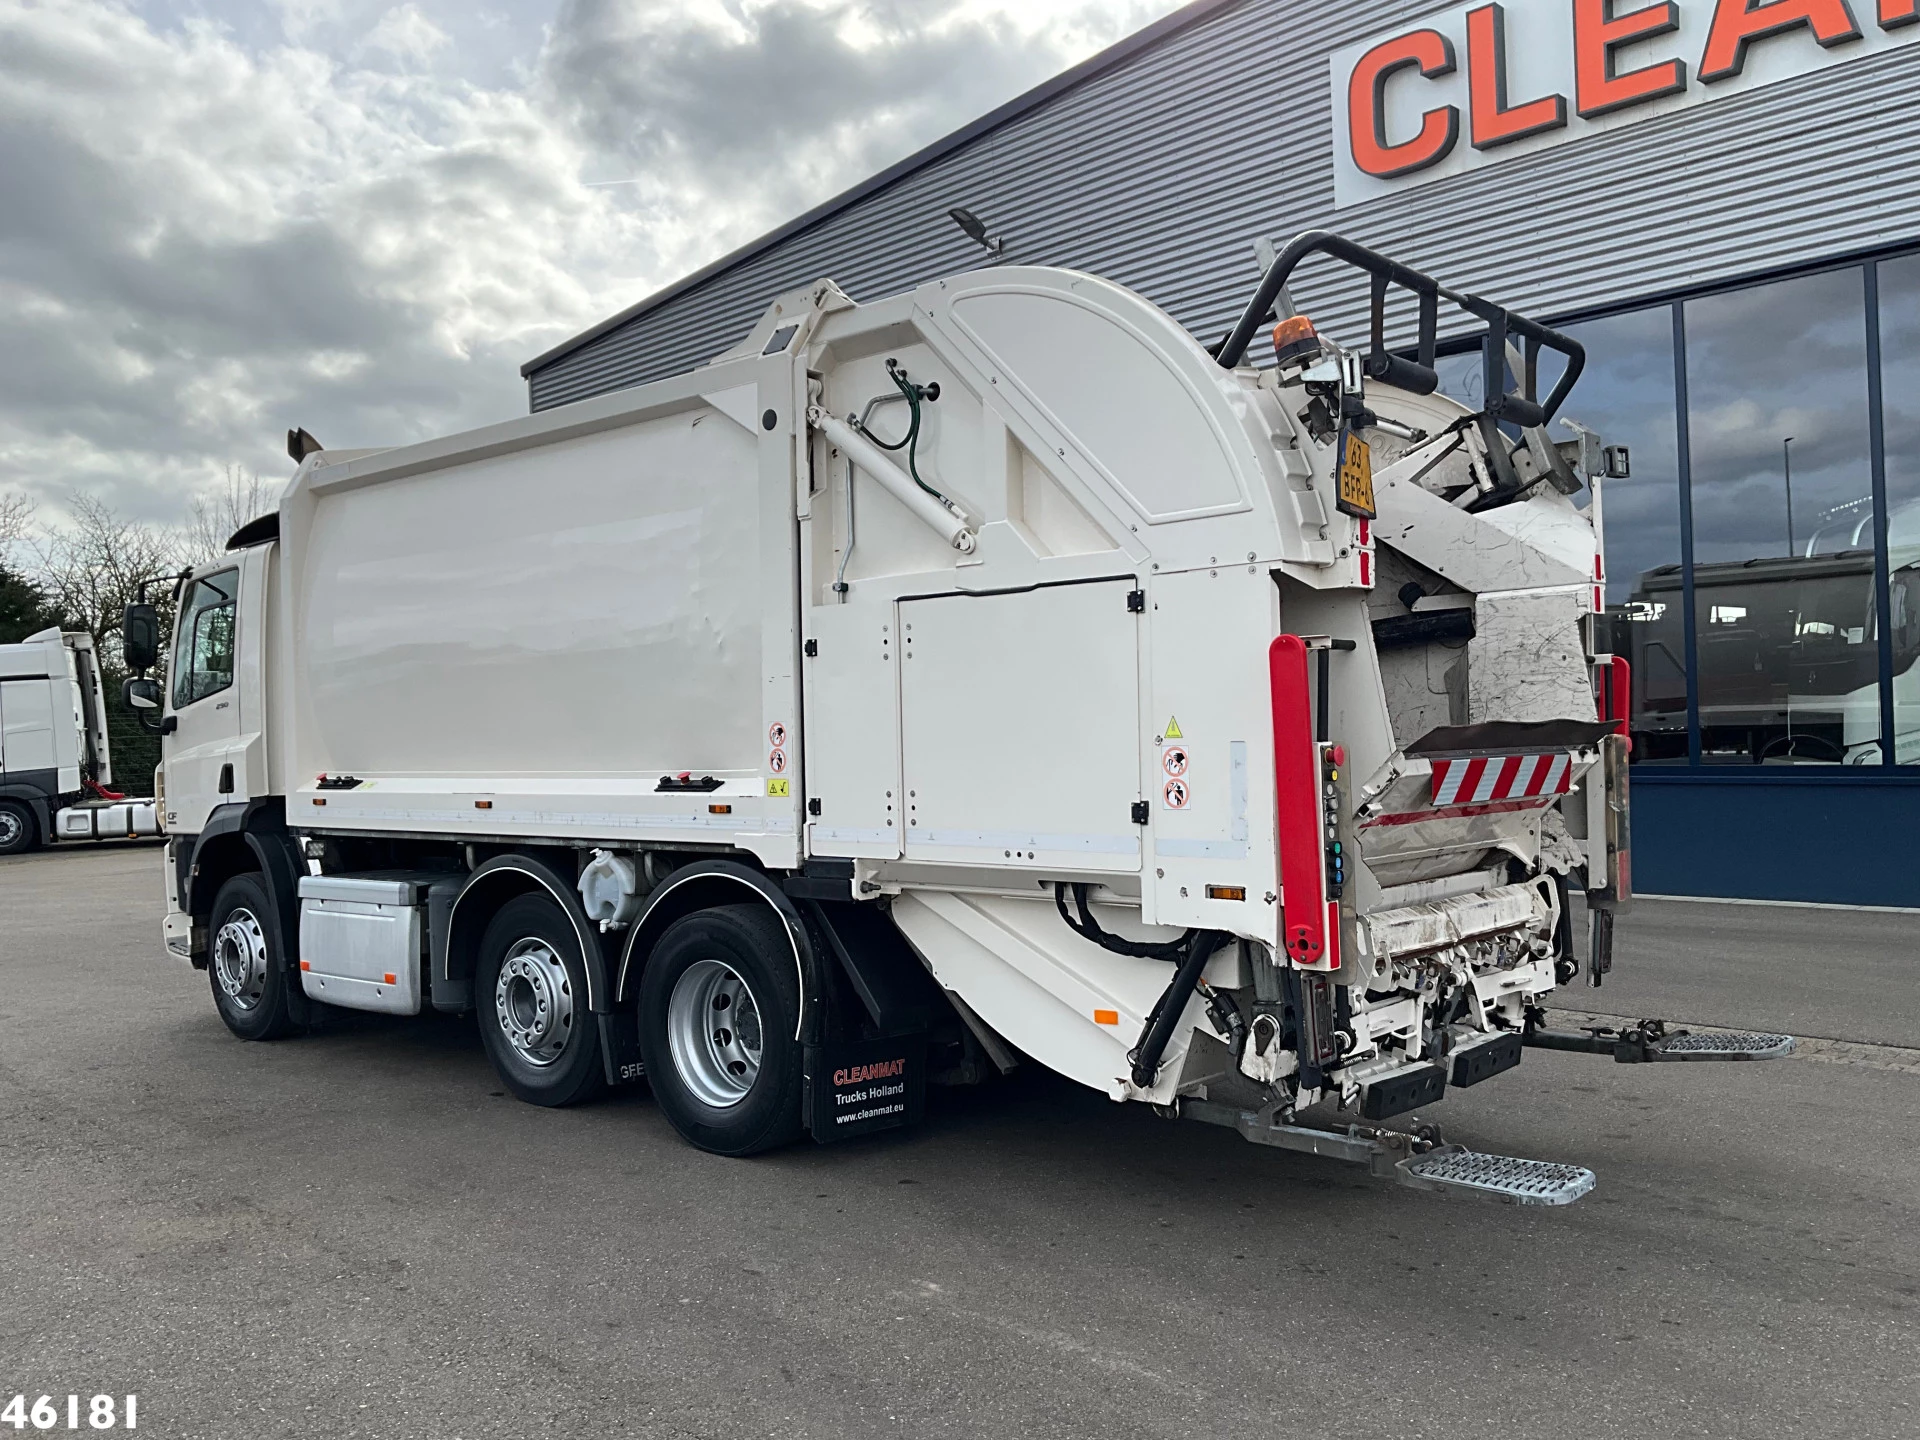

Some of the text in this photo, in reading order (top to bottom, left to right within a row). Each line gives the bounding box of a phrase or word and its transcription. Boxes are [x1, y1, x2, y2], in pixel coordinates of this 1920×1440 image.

[1348, 0, 1920, 180] CLEA
[833, 1059, 905, 1086] CLEANMAT
[835, 1082, 904, 1106] Trucks Holland
[836, 1103, 904, 1124] www.cleanmat.eu
